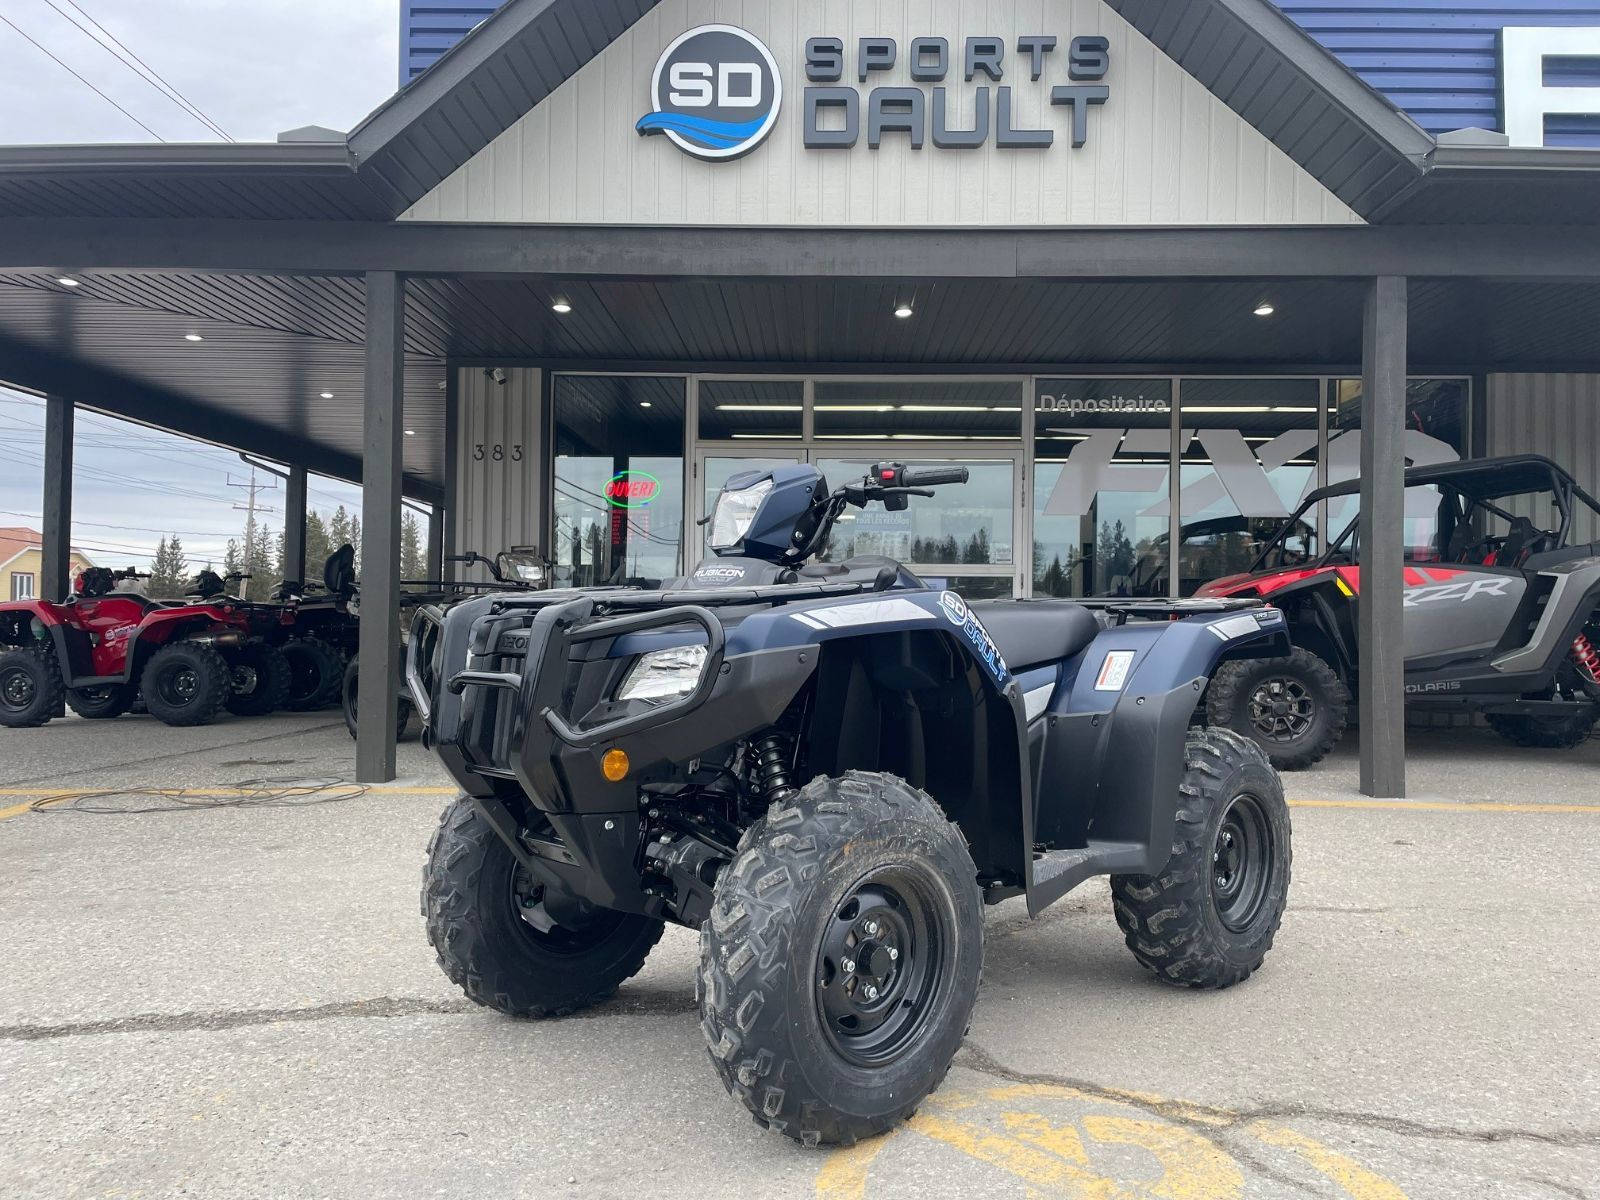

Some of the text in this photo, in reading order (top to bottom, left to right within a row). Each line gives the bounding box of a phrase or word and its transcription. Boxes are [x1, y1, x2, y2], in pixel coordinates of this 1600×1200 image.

[804, 36, 1110, 82] SPORTS
[668, 61, 762, 108] SD
[803, 85, 1109, 150] DAULT
[1039, 393, 1168, 417] Dépositaire
[473, 444, 523, 462] 383
[606, 481, 656, 498] OUVERT
[693, 568, 745, 578] RUBICON
[944, 594, 964, 617] SD
[963, 619, 1007, 682] DAULT
[967, 609, 1007, 670] SPORTS
[1404, 680, 1461, 693] OLARIS
